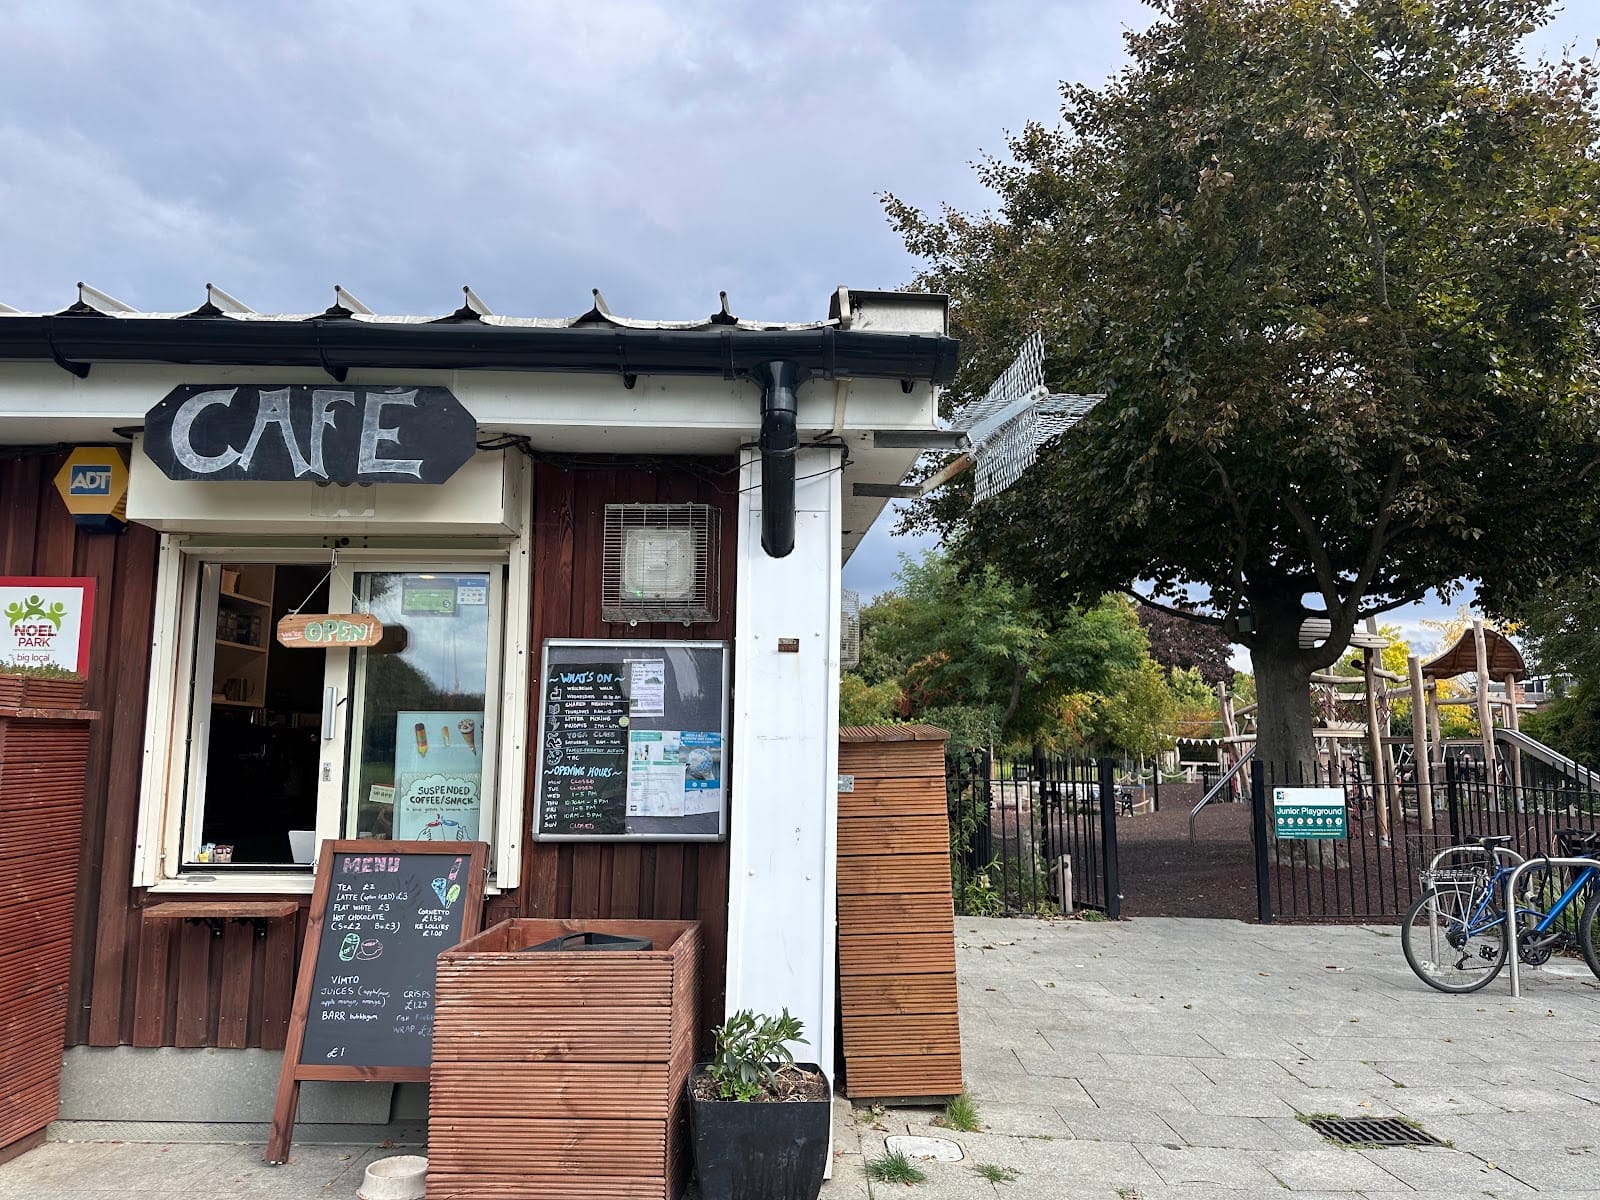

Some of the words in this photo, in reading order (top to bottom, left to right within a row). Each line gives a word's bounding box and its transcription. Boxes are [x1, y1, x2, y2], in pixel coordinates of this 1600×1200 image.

[71, 471, 111, 489] ADT
[14, 625, 57, 637] NOEL
[304, 619, 375, 643] OPEN!
[18, 637, 50, 647] PARK
[16, 653, 30, 663] big
[31, 653, 50, 662] local
[559, 671, 595, 684] WHAT'S
[596, 672, 613, 683] ON
[554, 764, 586, 776] OPENING
[587, 767, 613, 778] HOURS
[418, 785, 470, 795] SUSPENDED
[410, 795, 474, 805] COFFEE/SNACK
[1276, 807, 1300, 815] Junior
[1301, 807, 1342, 817] Playground
[343, 856, 400, 873] MENU
[337, 883, 352, 891] TEA
[362, 883, 375, 891] £2
[336, 892, 358, 901] LATTE
[333, 903, 350, 912] FLAT
[378, 903, 390, 911] £3
[418, 907, 450, 916] CORNETTO
[332, 913, 346, 922] HOT
[347, 913, 385, 921] CHOCOLATE
[424, 923, 450, 931] LOLLIES
[331, 975, 360, 985] VIMTO
[320, 986, 354, 995] JUICES
[403, 989, 431, 999] CRISPS
[321, 1010, 346, 1021] BARR
[326, 1047, 345, 1058] £1
